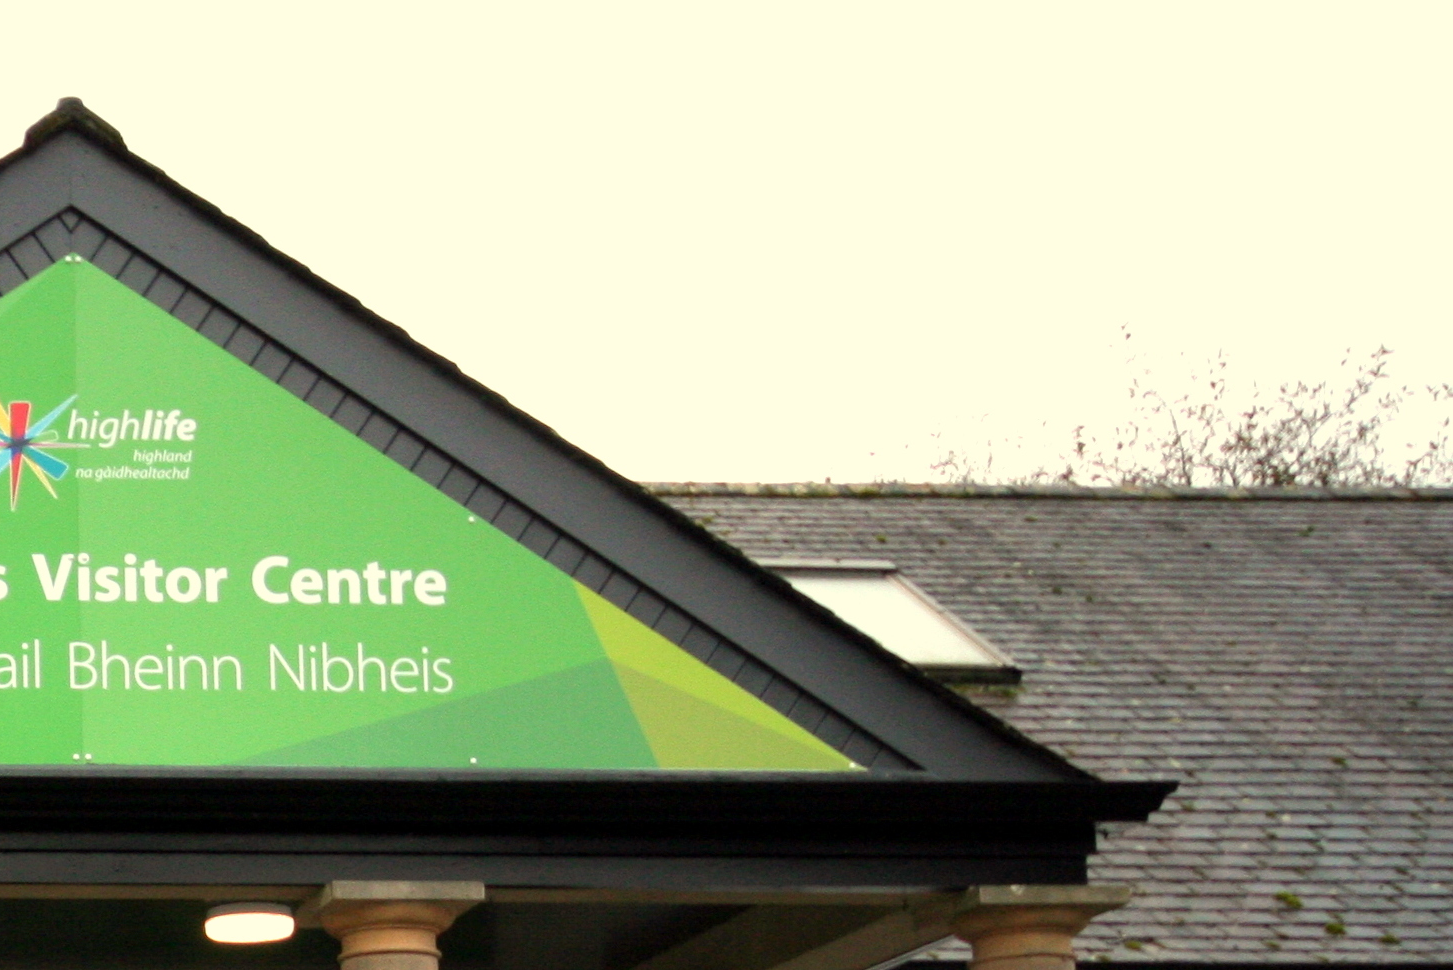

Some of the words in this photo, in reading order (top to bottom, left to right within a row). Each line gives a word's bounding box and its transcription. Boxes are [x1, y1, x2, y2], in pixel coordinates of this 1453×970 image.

[67, 408, 198, 449] highlife
[75, 466, 93, 479] na
[94, 465, 191, 482] gàidhealtachd
[132, 449, 193, 465] highland
[31, 552, 229, 604] Visitor
[251, 555, 449, 607] Centre
[68, 640, 244, 692] Bheinn
[269, 643, 455, 695] Nibheis
